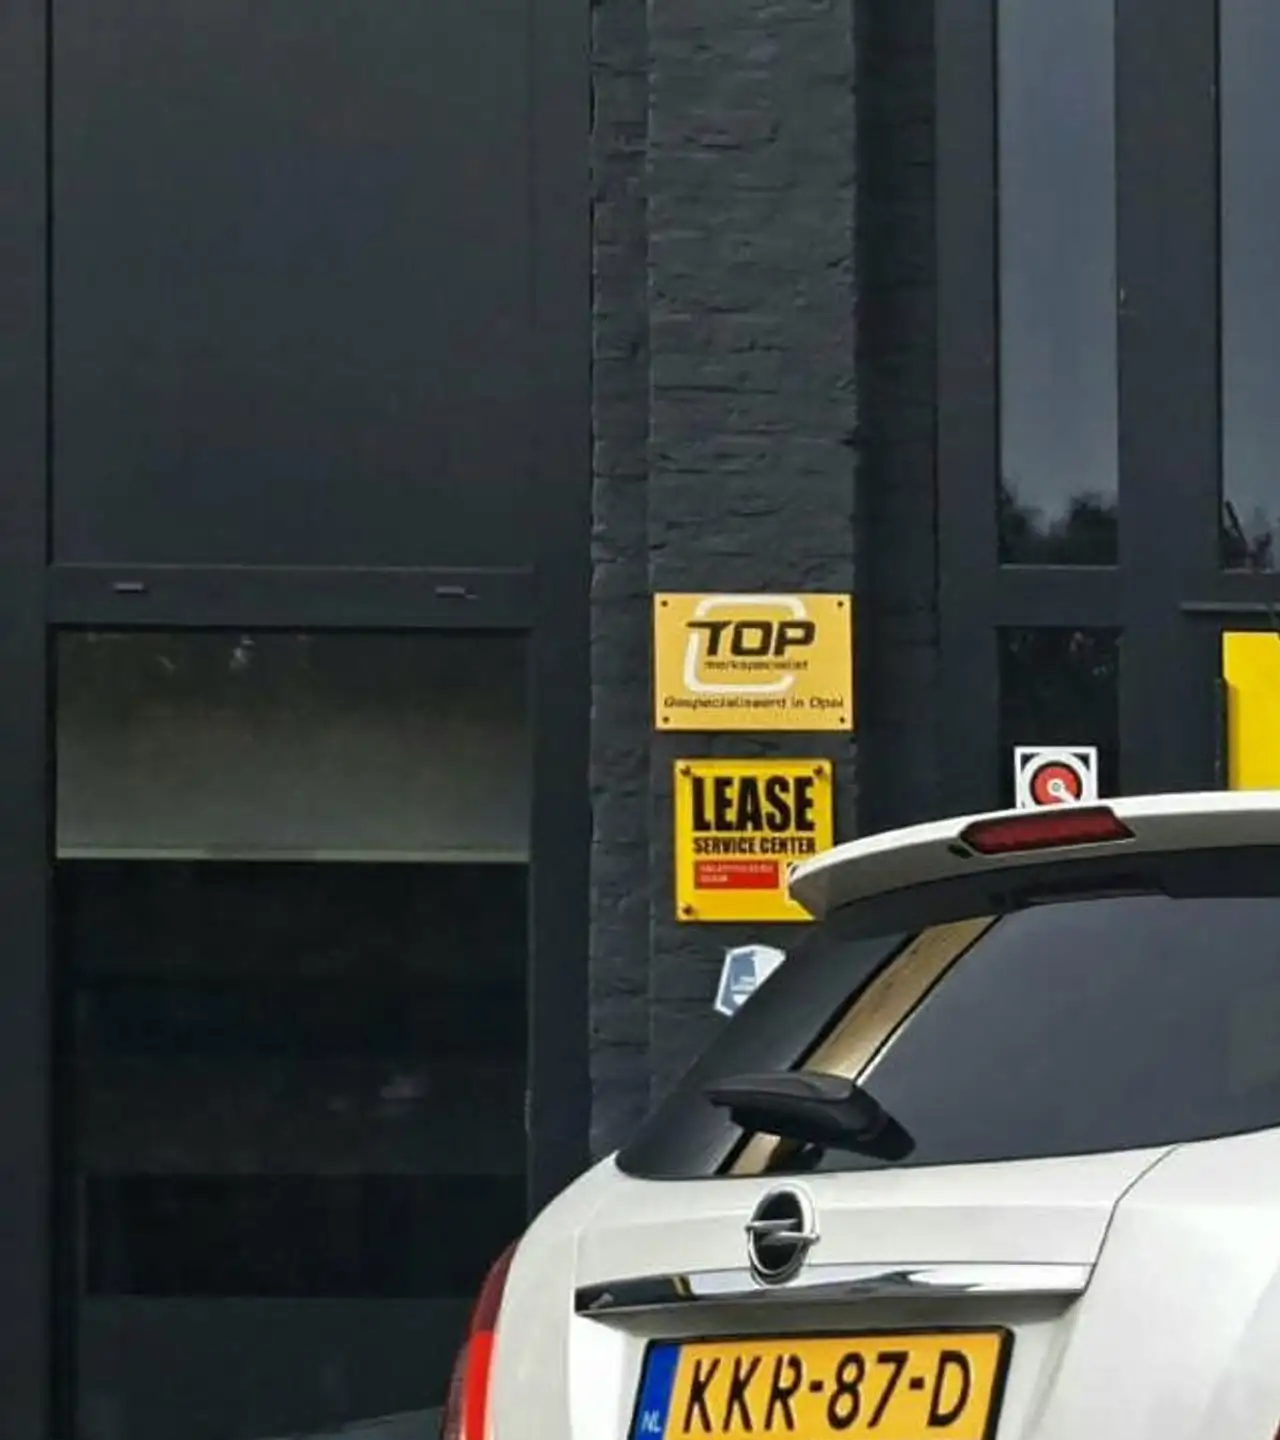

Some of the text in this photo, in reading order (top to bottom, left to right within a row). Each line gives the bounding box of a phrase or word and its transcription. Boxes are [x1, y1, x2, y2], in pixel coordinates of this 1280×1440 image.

[684, 620, 816, 657] TOP
[791, 696, 804, 709] in
[692, 775, 816, 833] LEASE
[693, 836, 816, 854] SERVICE CENTER
[682, 1350, 972, 1435] KKR-87-D
[640, 1410, 662, 1433] NL
